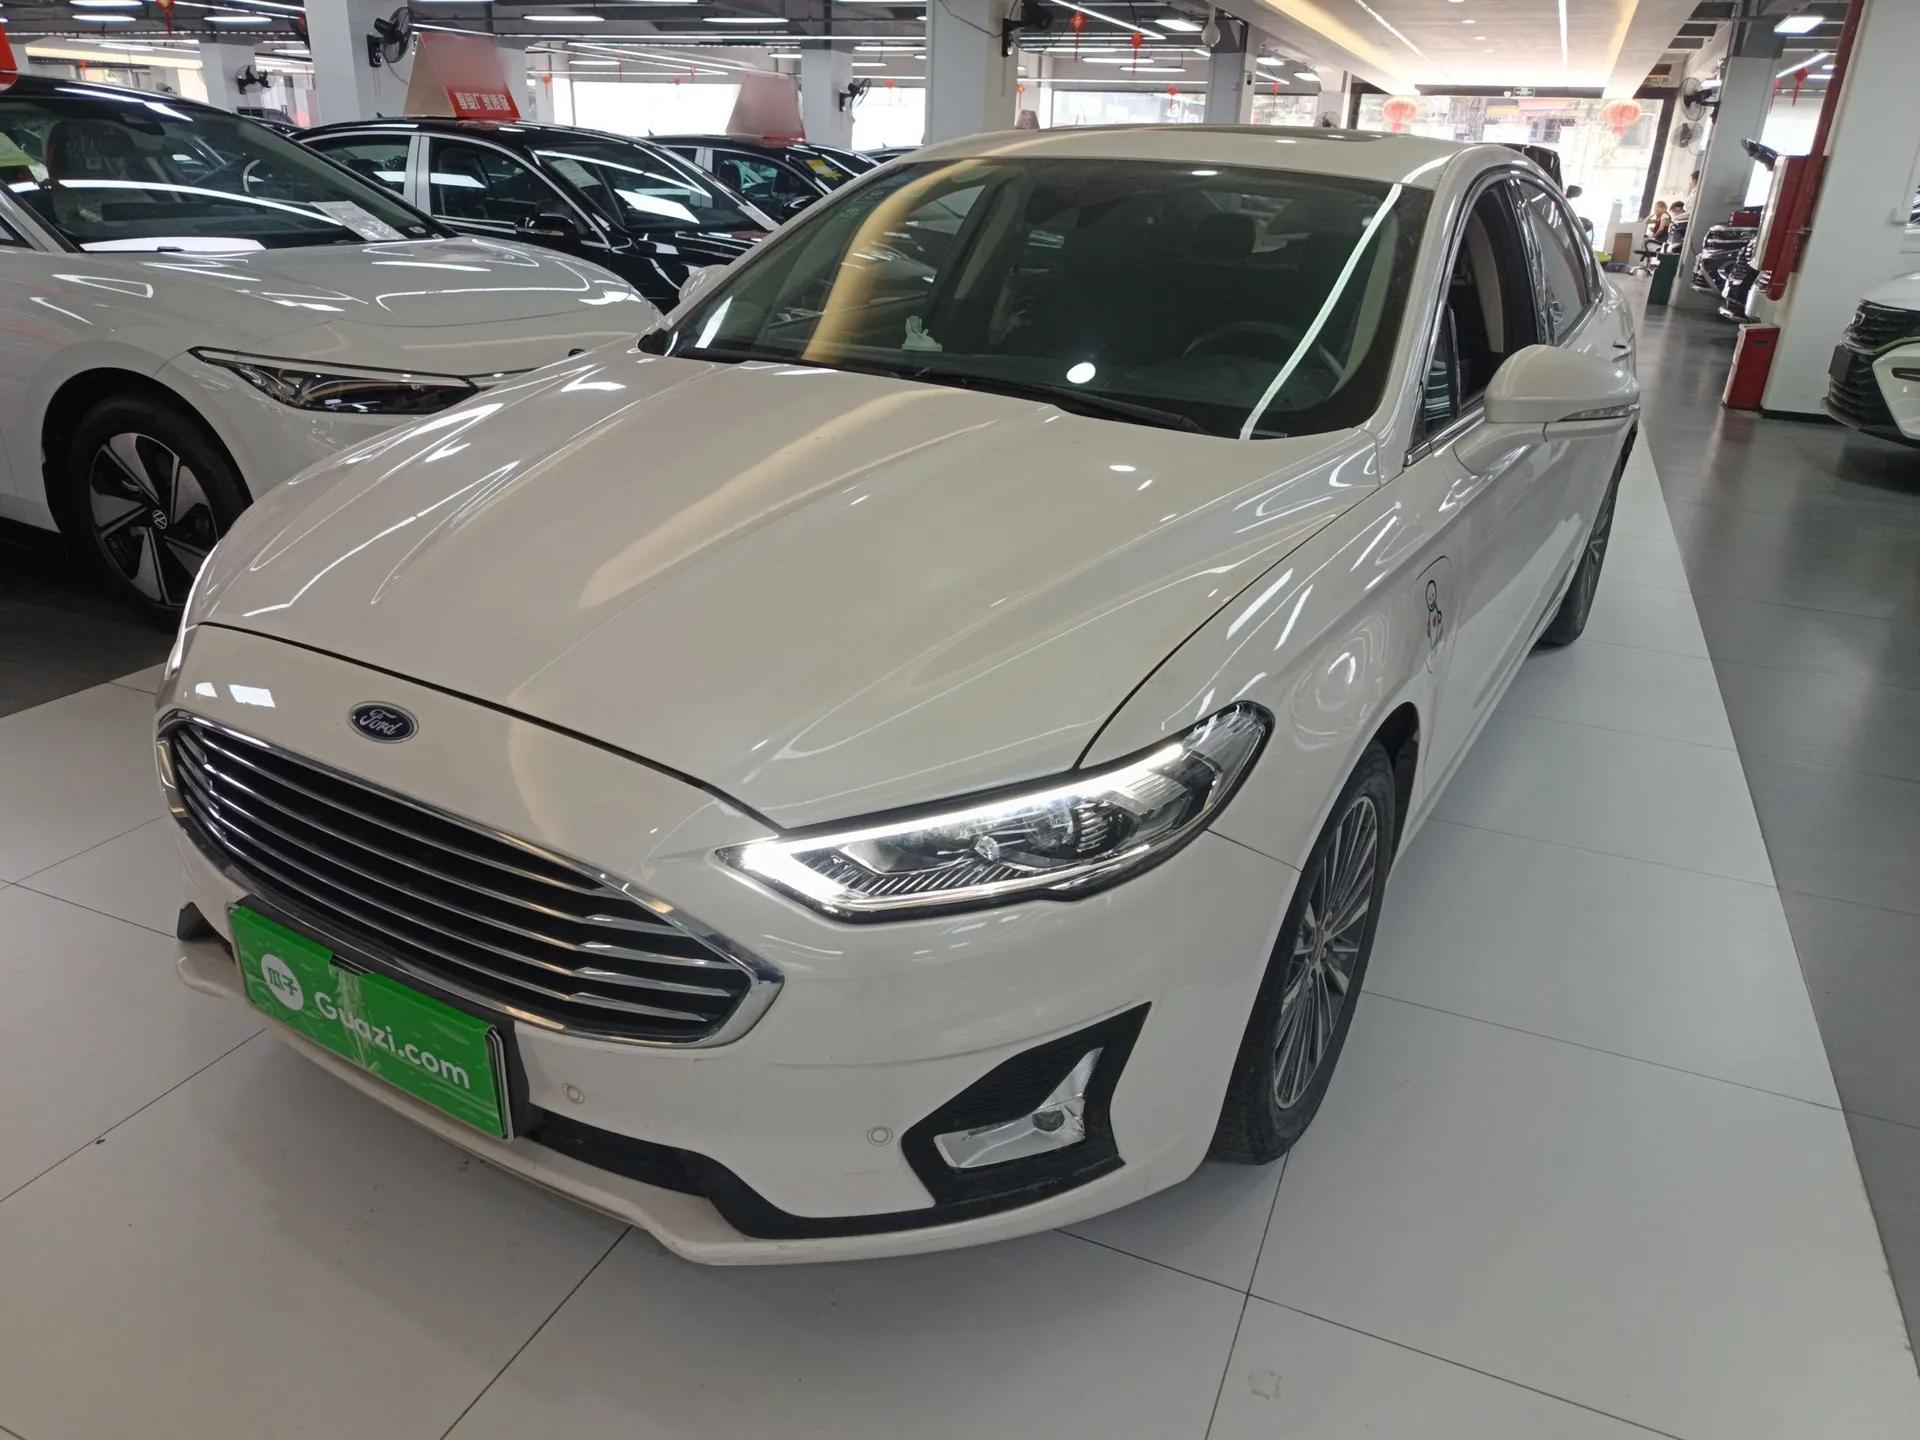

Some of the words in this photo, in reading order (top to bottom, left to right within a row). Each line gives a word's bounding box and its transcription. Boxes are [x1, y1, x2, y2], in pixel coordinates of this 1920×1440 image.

[360, 708, 403, 735] Ford
[266, 966, 298, 996] 瓜子
[314, 991, 470, 1089] Guazi.com
